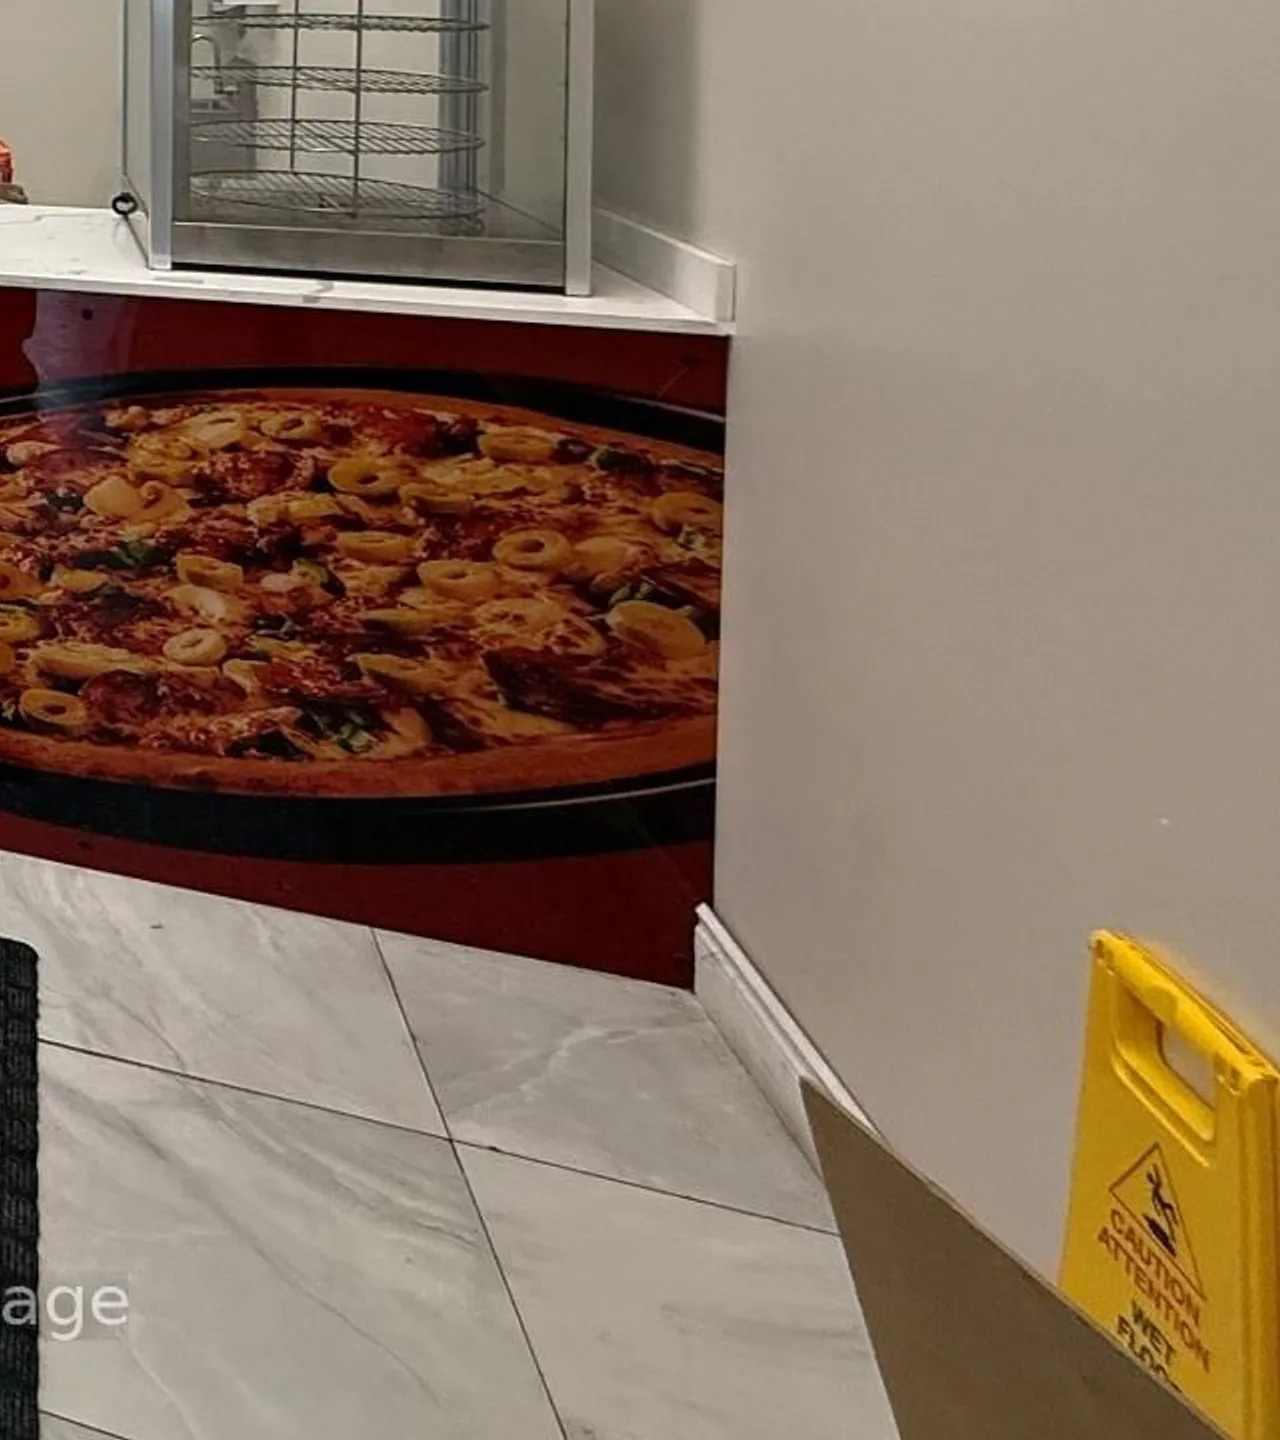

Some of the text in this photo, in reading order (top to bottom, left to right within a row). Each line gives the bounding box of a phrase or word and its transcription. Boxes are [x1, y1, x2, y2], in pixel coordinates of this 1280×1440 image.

[1097, 1225, 1212, 1374] ATTENTION
[1109, 1208, 1201, 1328] CAUTION
[1132, 1297, 1177, 1364] WET
